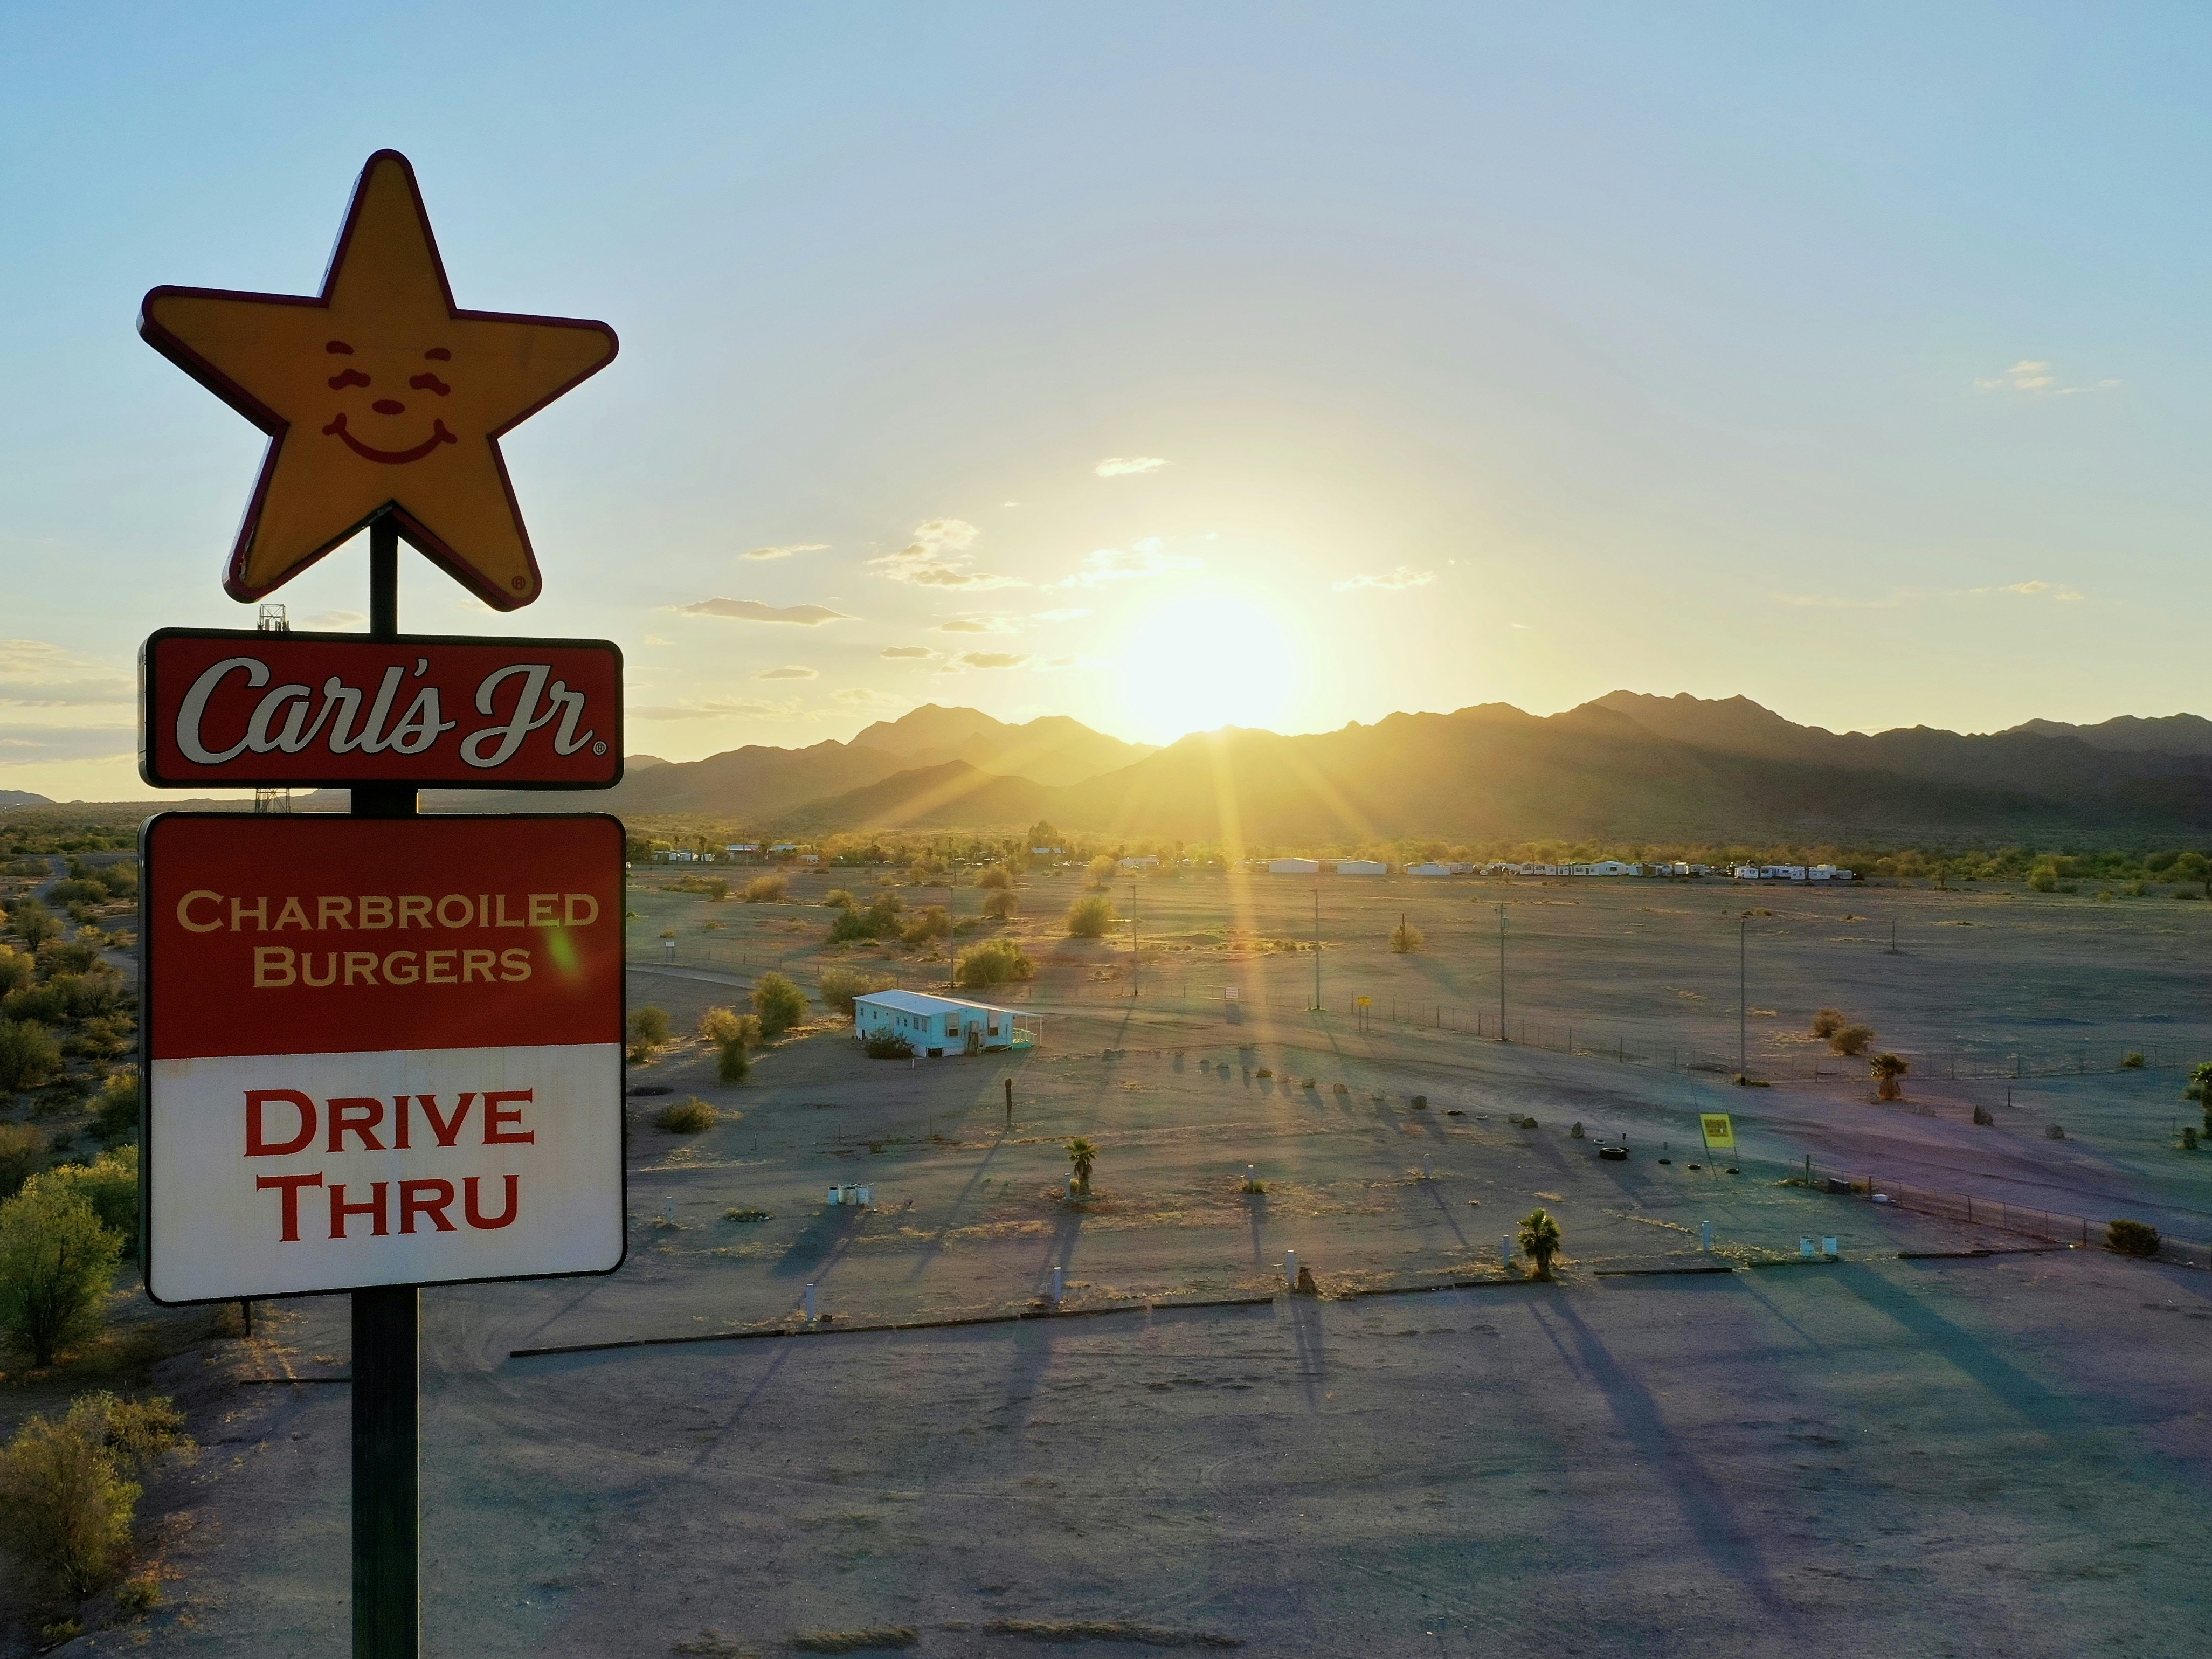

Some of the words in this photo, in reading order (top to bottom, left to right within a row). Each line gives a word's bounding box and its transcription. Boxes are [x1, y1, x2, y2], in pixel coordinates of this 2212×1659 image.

[176, 658, 456, 764] Carl's
[177, 890, 599, 932] CHARBROILED
[253, 946, 532, 987] BURGERS
[244, 1087, 535, 1157] DRIVE
[255, 1171, 520, 1242] THRU
